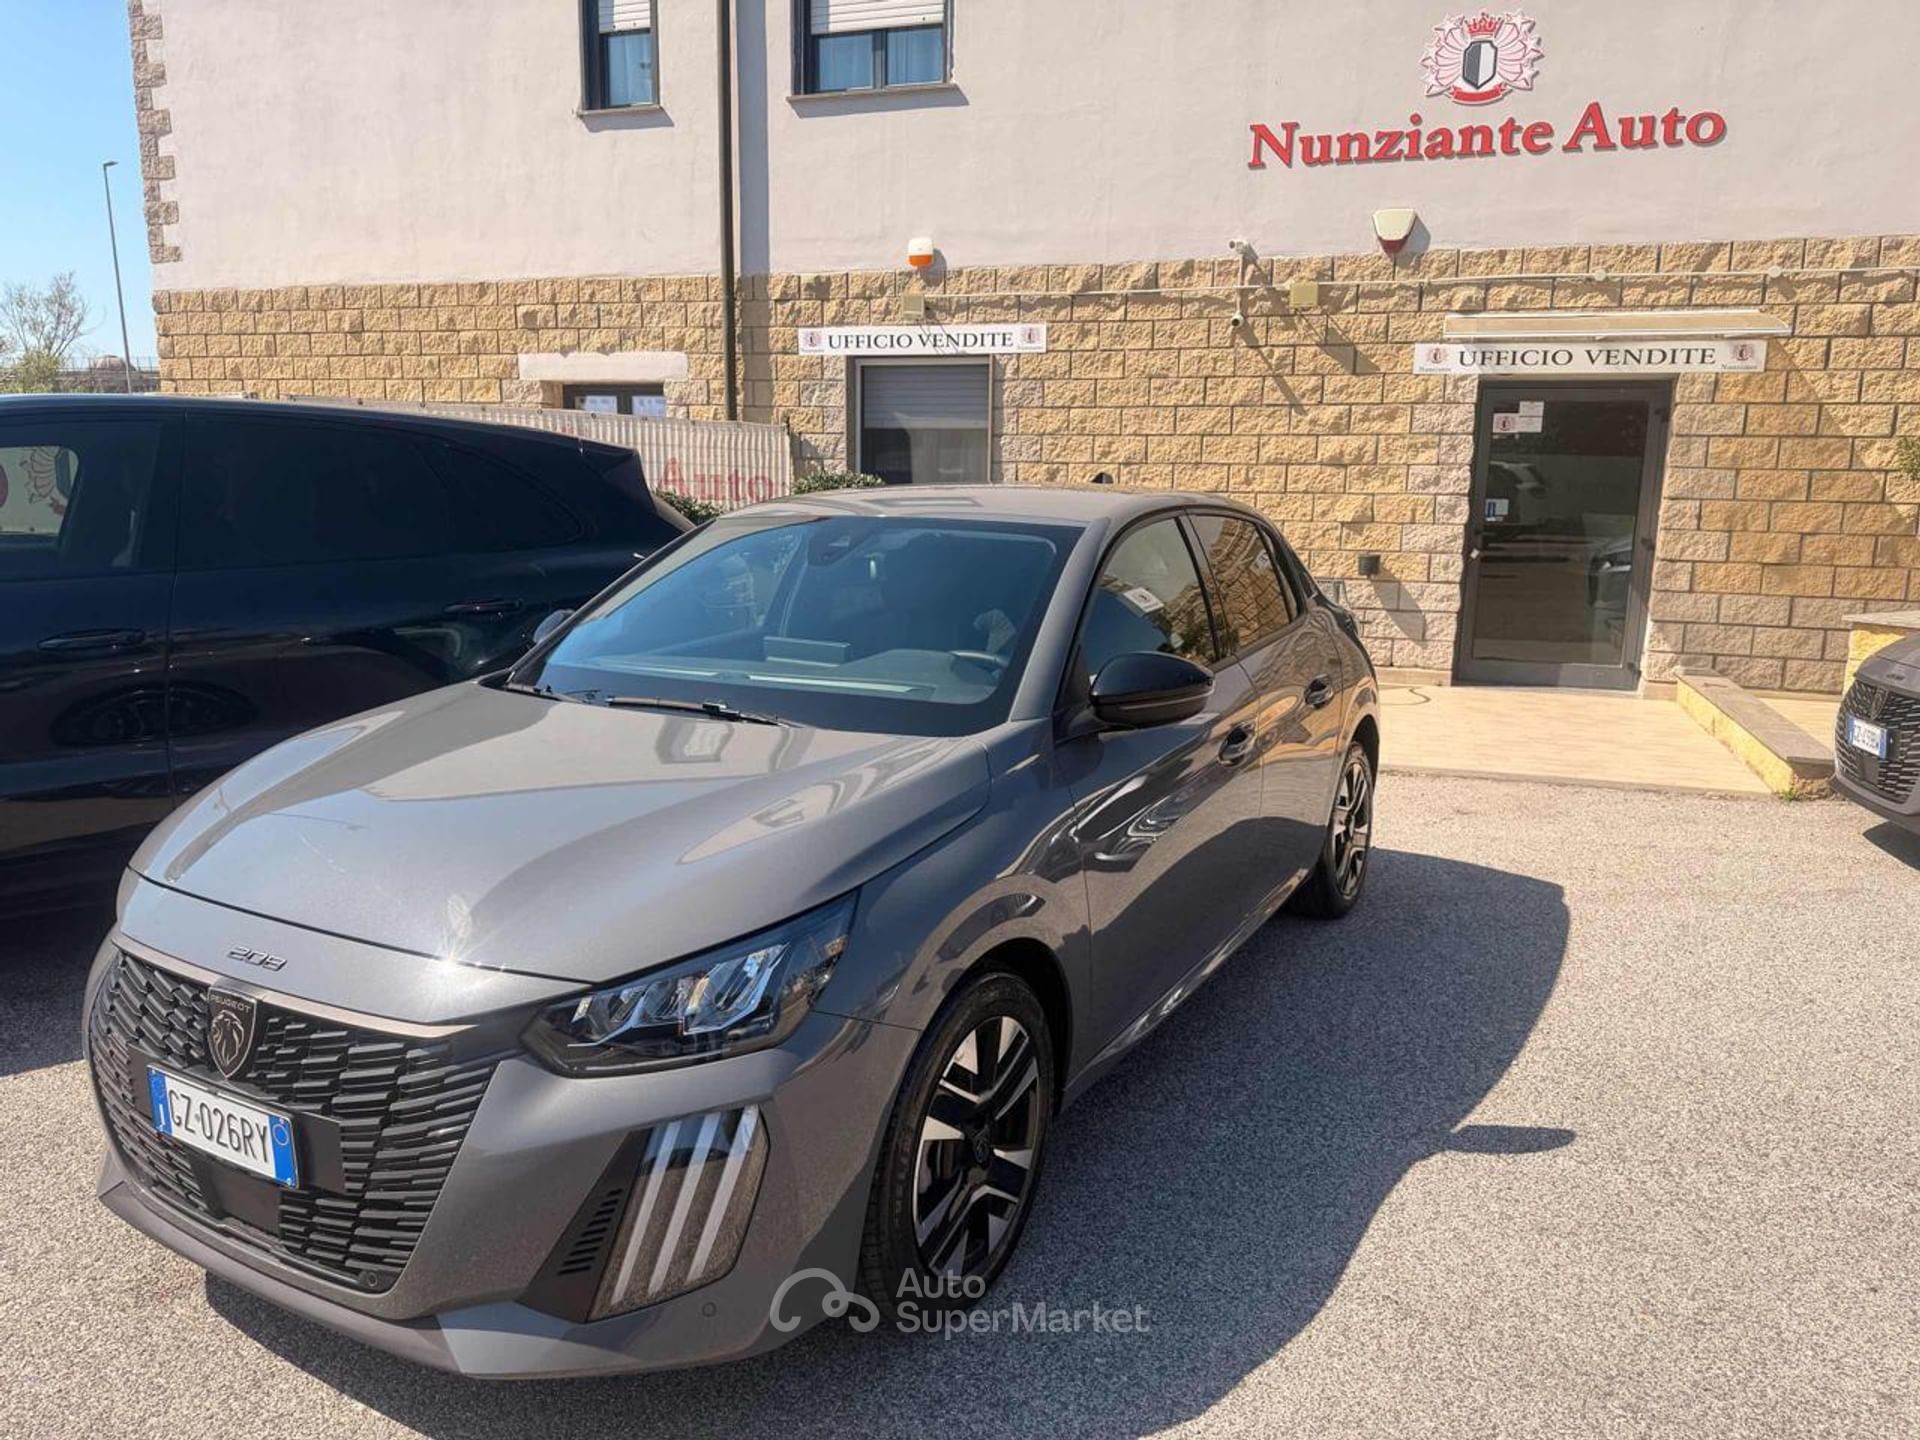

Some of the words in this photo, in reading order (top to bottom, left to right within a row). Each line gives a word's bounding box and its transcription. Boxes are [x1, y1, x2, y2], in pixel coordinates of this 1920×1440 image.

[1248, 112, 1554, 169] Nunziante
[1563, 101, 1727, 152] Auto
[828, 333, 913, 349] UFFICIO
[918, 331, 1014, 348] VENDITE
[1459, 349, 1574, 366] UFFICIO
[1584, 347, 1716, 366] VENDITE
[658, 456, 774, 503] Auto
[227, 945, 288, 972] 208
